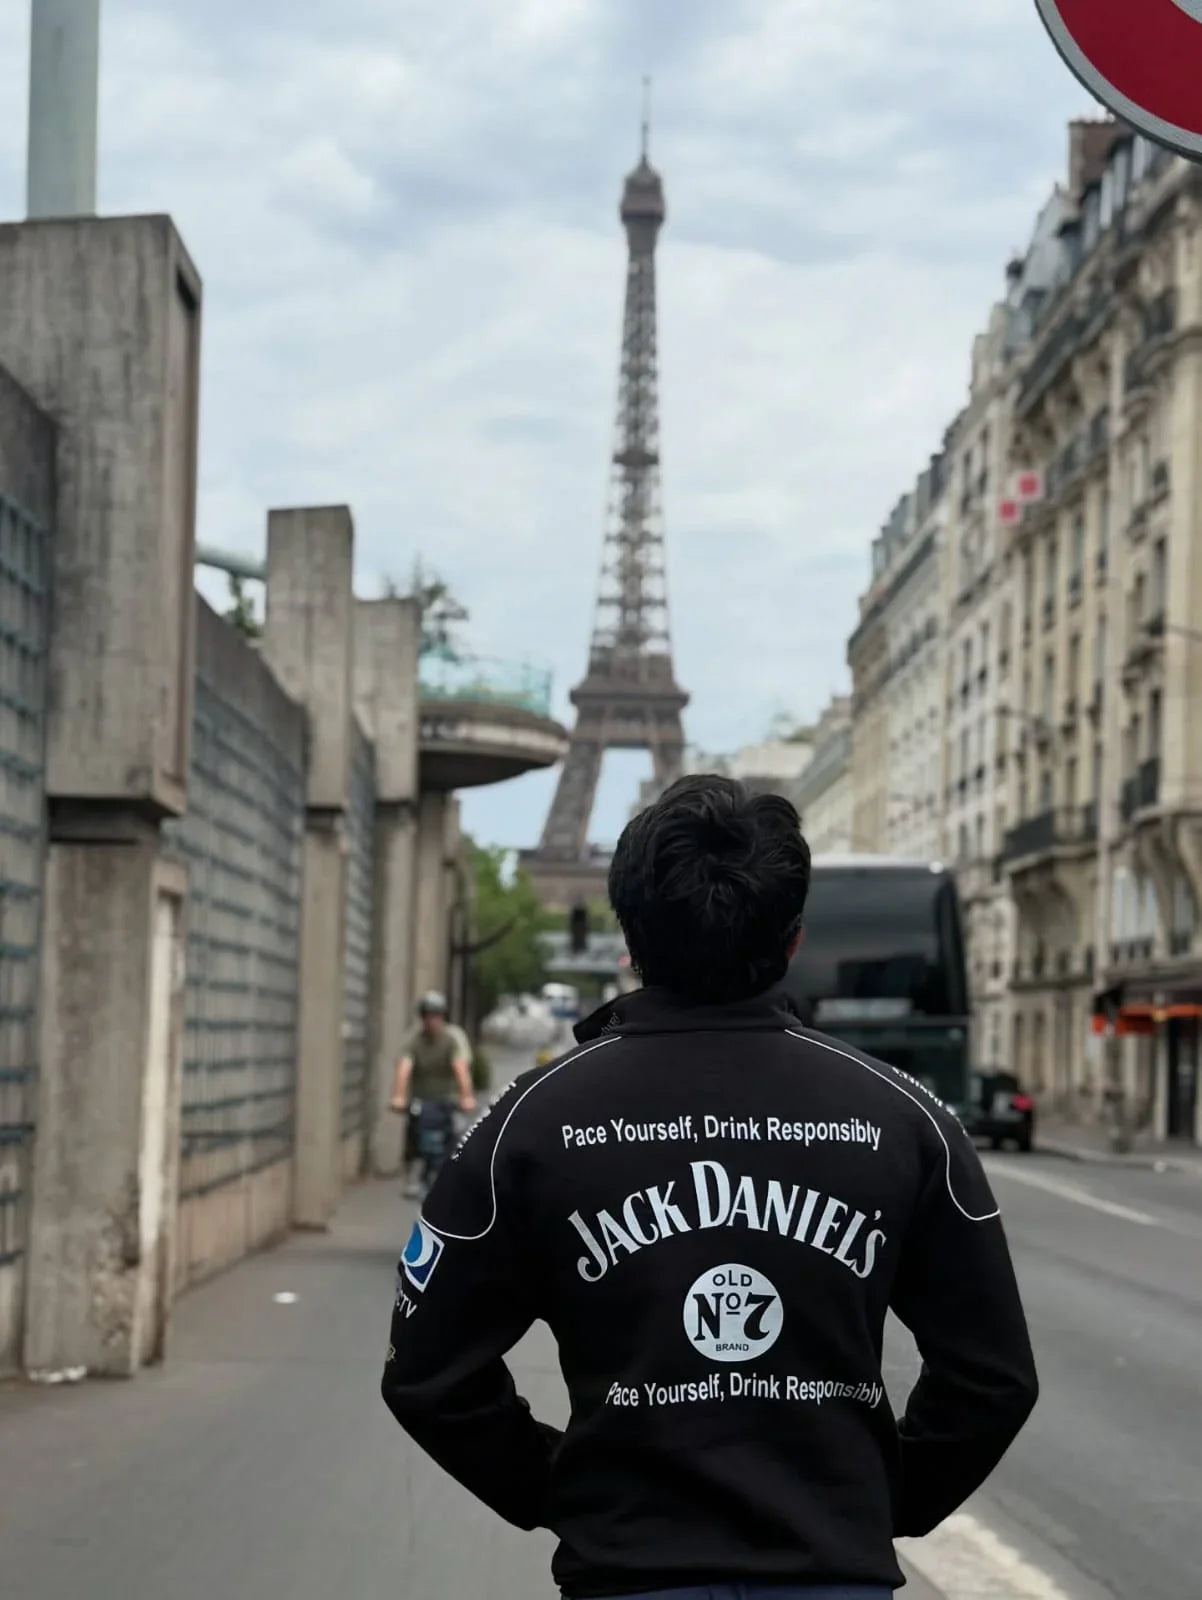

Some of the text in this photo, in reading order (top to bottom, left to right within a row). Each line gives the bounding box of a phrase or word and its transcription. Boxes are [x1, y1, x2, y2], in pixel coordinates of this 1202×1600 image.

[562, 1115, 881, 1151] Pace Yourself, Drink Responsibly
[567, 1180, 693, 1282] JACK
[712, 1269, 753, 1287] OLD
[715, 1343, 749, 1352] BRAND
[605, 1372, 883, 1408] Pace Yourself, Drink Responsibly
